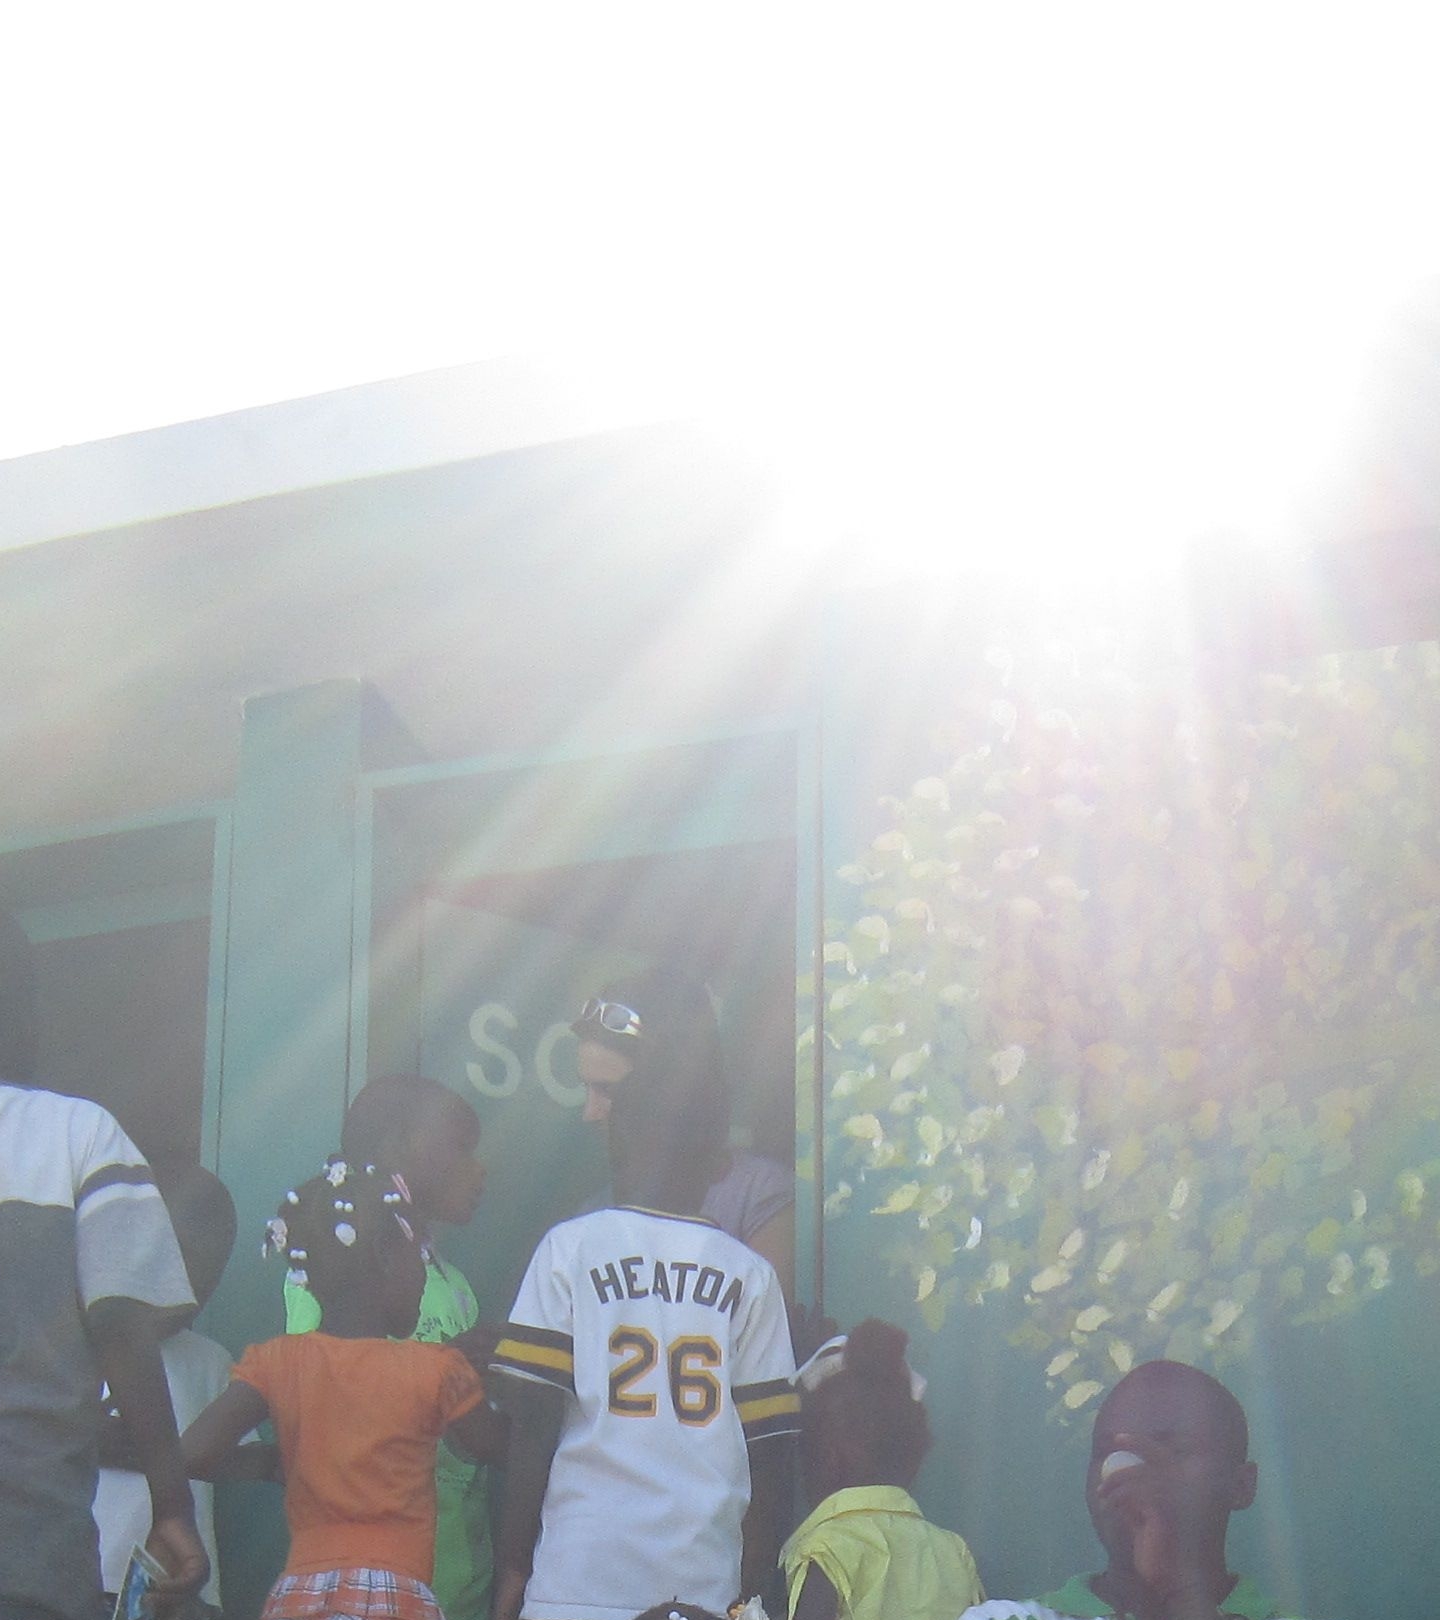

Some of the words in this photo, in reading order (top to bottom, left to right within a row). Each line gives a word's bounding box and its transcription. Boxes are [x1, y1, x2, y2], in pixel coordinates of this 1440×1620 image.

[464, 1001, 588, 1108] SO
[589, 1256, 744, 1314] HEATON
[608, 1323, 723, 1429] 26
